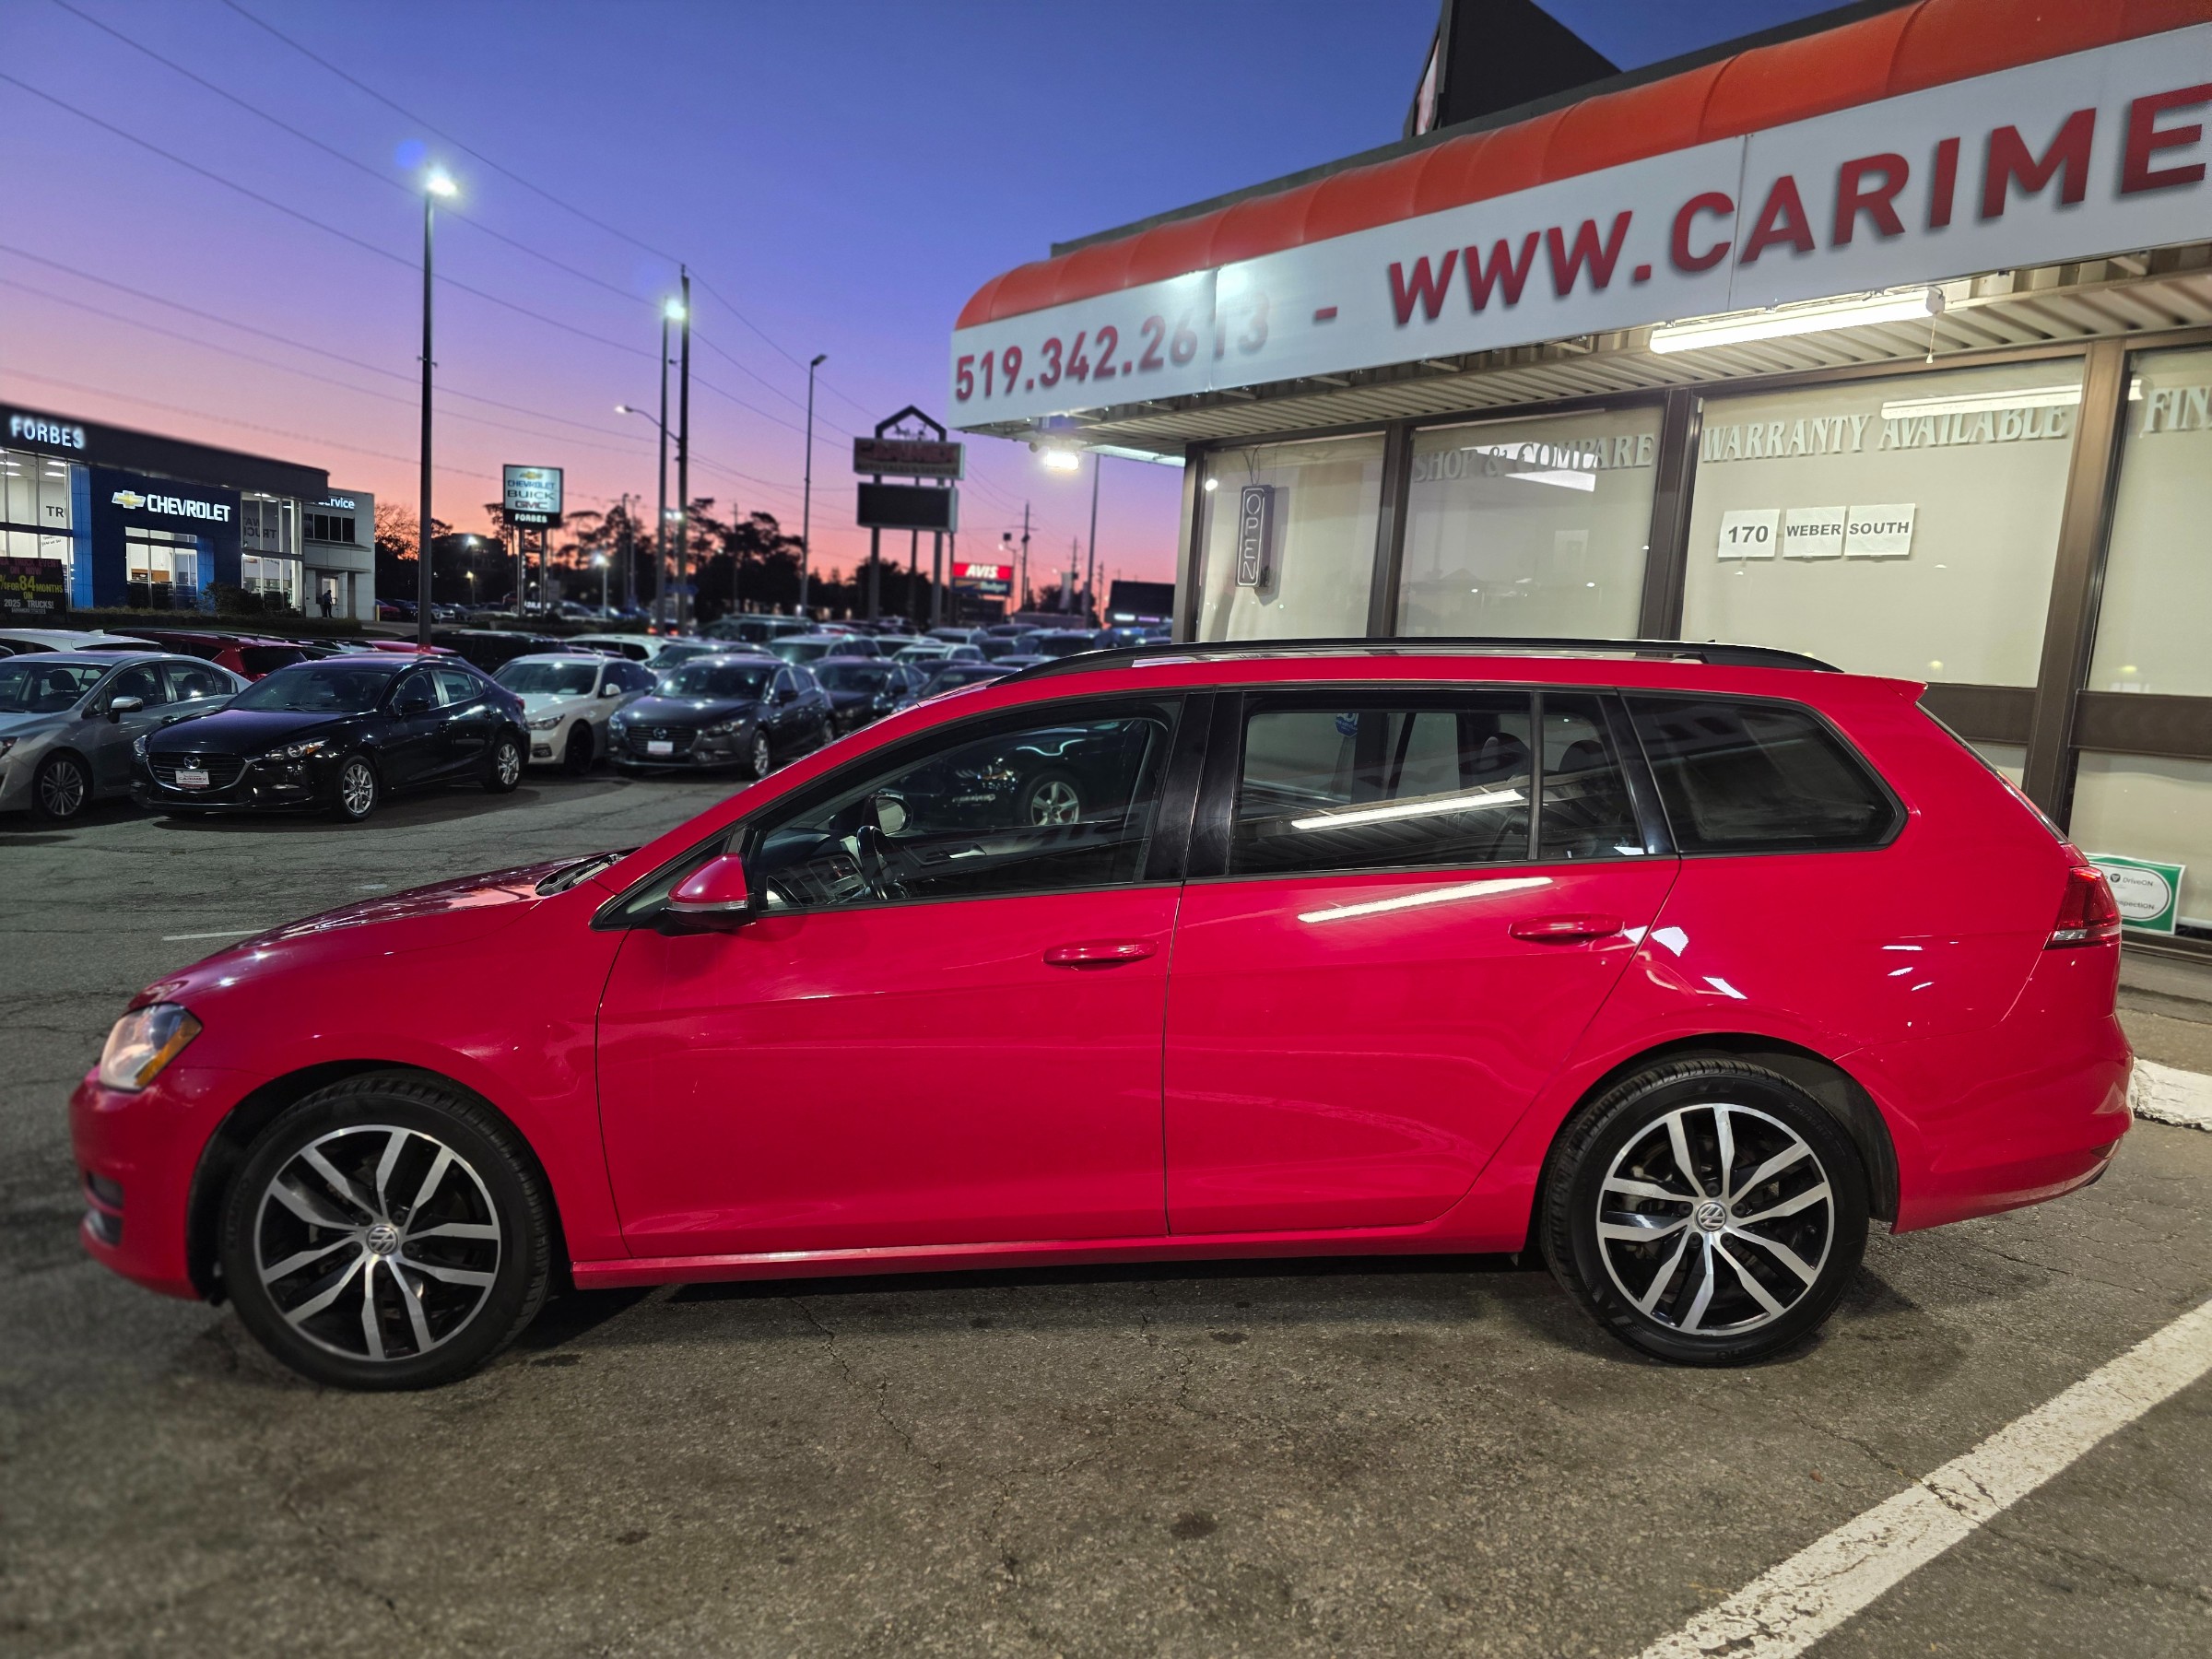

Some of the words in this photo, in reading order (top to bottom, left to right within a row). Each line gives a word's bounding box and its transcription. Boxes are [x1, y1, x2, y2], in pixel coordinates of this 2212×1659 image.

[10, 414, 86, 449] FORBES
[1702, 413, 1873, 462] WARRANTY
[1879, 403, 2069, 451] AVAILABLE
[1413, 447, 1477, 482] SHOP
[1484, 446, 1509, 477] &
[1516, 432, 1655, 473] COMPARE
[508, 479, 555, 489] CHEVROLET
[507, 489, 555, 500] BUICK
[147, 493, 231, 523] CHEVROLET
[515, 500, 547, 510] GMC
[46, 505, 65, 518] TR
[514, 513, 547, 524] FORBES
[1241, 493, 1262, 581] OPEN
[1728, 525, 1769, 544] 170
[1786, 524, 1841, 536] WEBER
[1849, 522, 1910, 535] SOUTH
[39, 559, 59, 568] EVENT
[965, 563, 999, 579] AVIS
[19, 575, 36, 591] 84
[36, 583, 64, 593] MONTHS
[23, 591, 33, 600] ON
[4, 599, 21, 607] 2025
[27, 600, 54, 609] TRUCKS!
[2123, 877, 2153, 886] DriveON
[2116, 900, 2155, 910] spectiON
